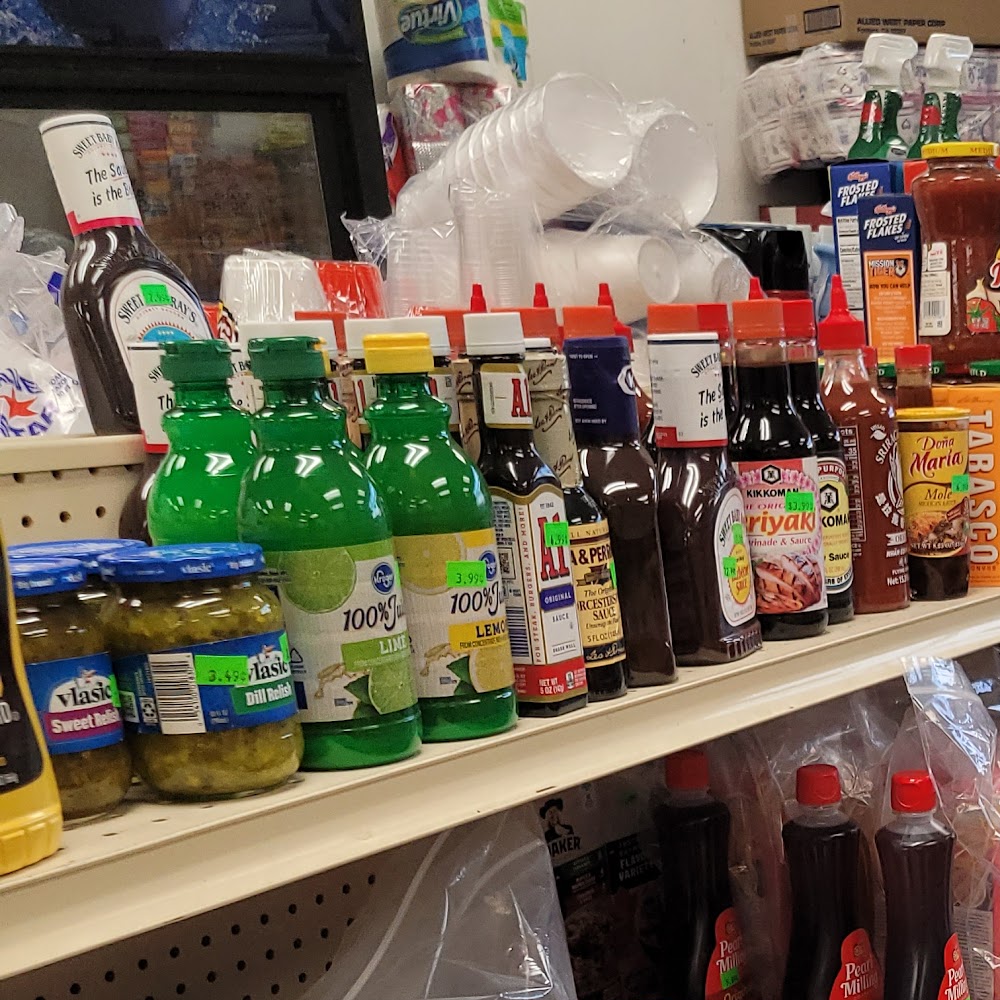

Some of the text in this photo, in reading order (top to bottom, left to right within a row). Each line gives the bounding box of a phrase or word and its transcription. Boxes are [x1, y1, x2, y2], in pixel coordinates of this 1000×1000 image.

[86, 167, 108, 185] The
[93, 186, 123, 207] is the
[838, 178, 879, 198] FROSTED
[863, 213, 907, 231] FROSTED
[867, 224, 903, 239] FLAKES
[869, 259, 895, 268] MISSION
[118, 292, 144, 325] SWEET
[690, 353, 714, 378] SWEET
[698, 388, 718, 408] The
[700, 409, 723, 429] is the
[917, 436, 955, 452] Doña
[969, 409, 999, 566] TABASCO
[521, 541, 529, 559] AND
[789, 536, 813, 546] Sauce
[829, 552, 850, 562] Sauce
[373, 570, 395, 586] Kroger
[449, 589, 492, 615] 100%
[543, 591, 572, 605] ORIGINAL
[343, 602, 389, 632] 100%
[552, 613, 569, 623] SAUCE
[592, 607, 617, 622] SAUCE
[379, 635, 408, 656] LIME
[245, 682, 293, 707] Dill Relish
[51, 712, 94, 735] Sweet
